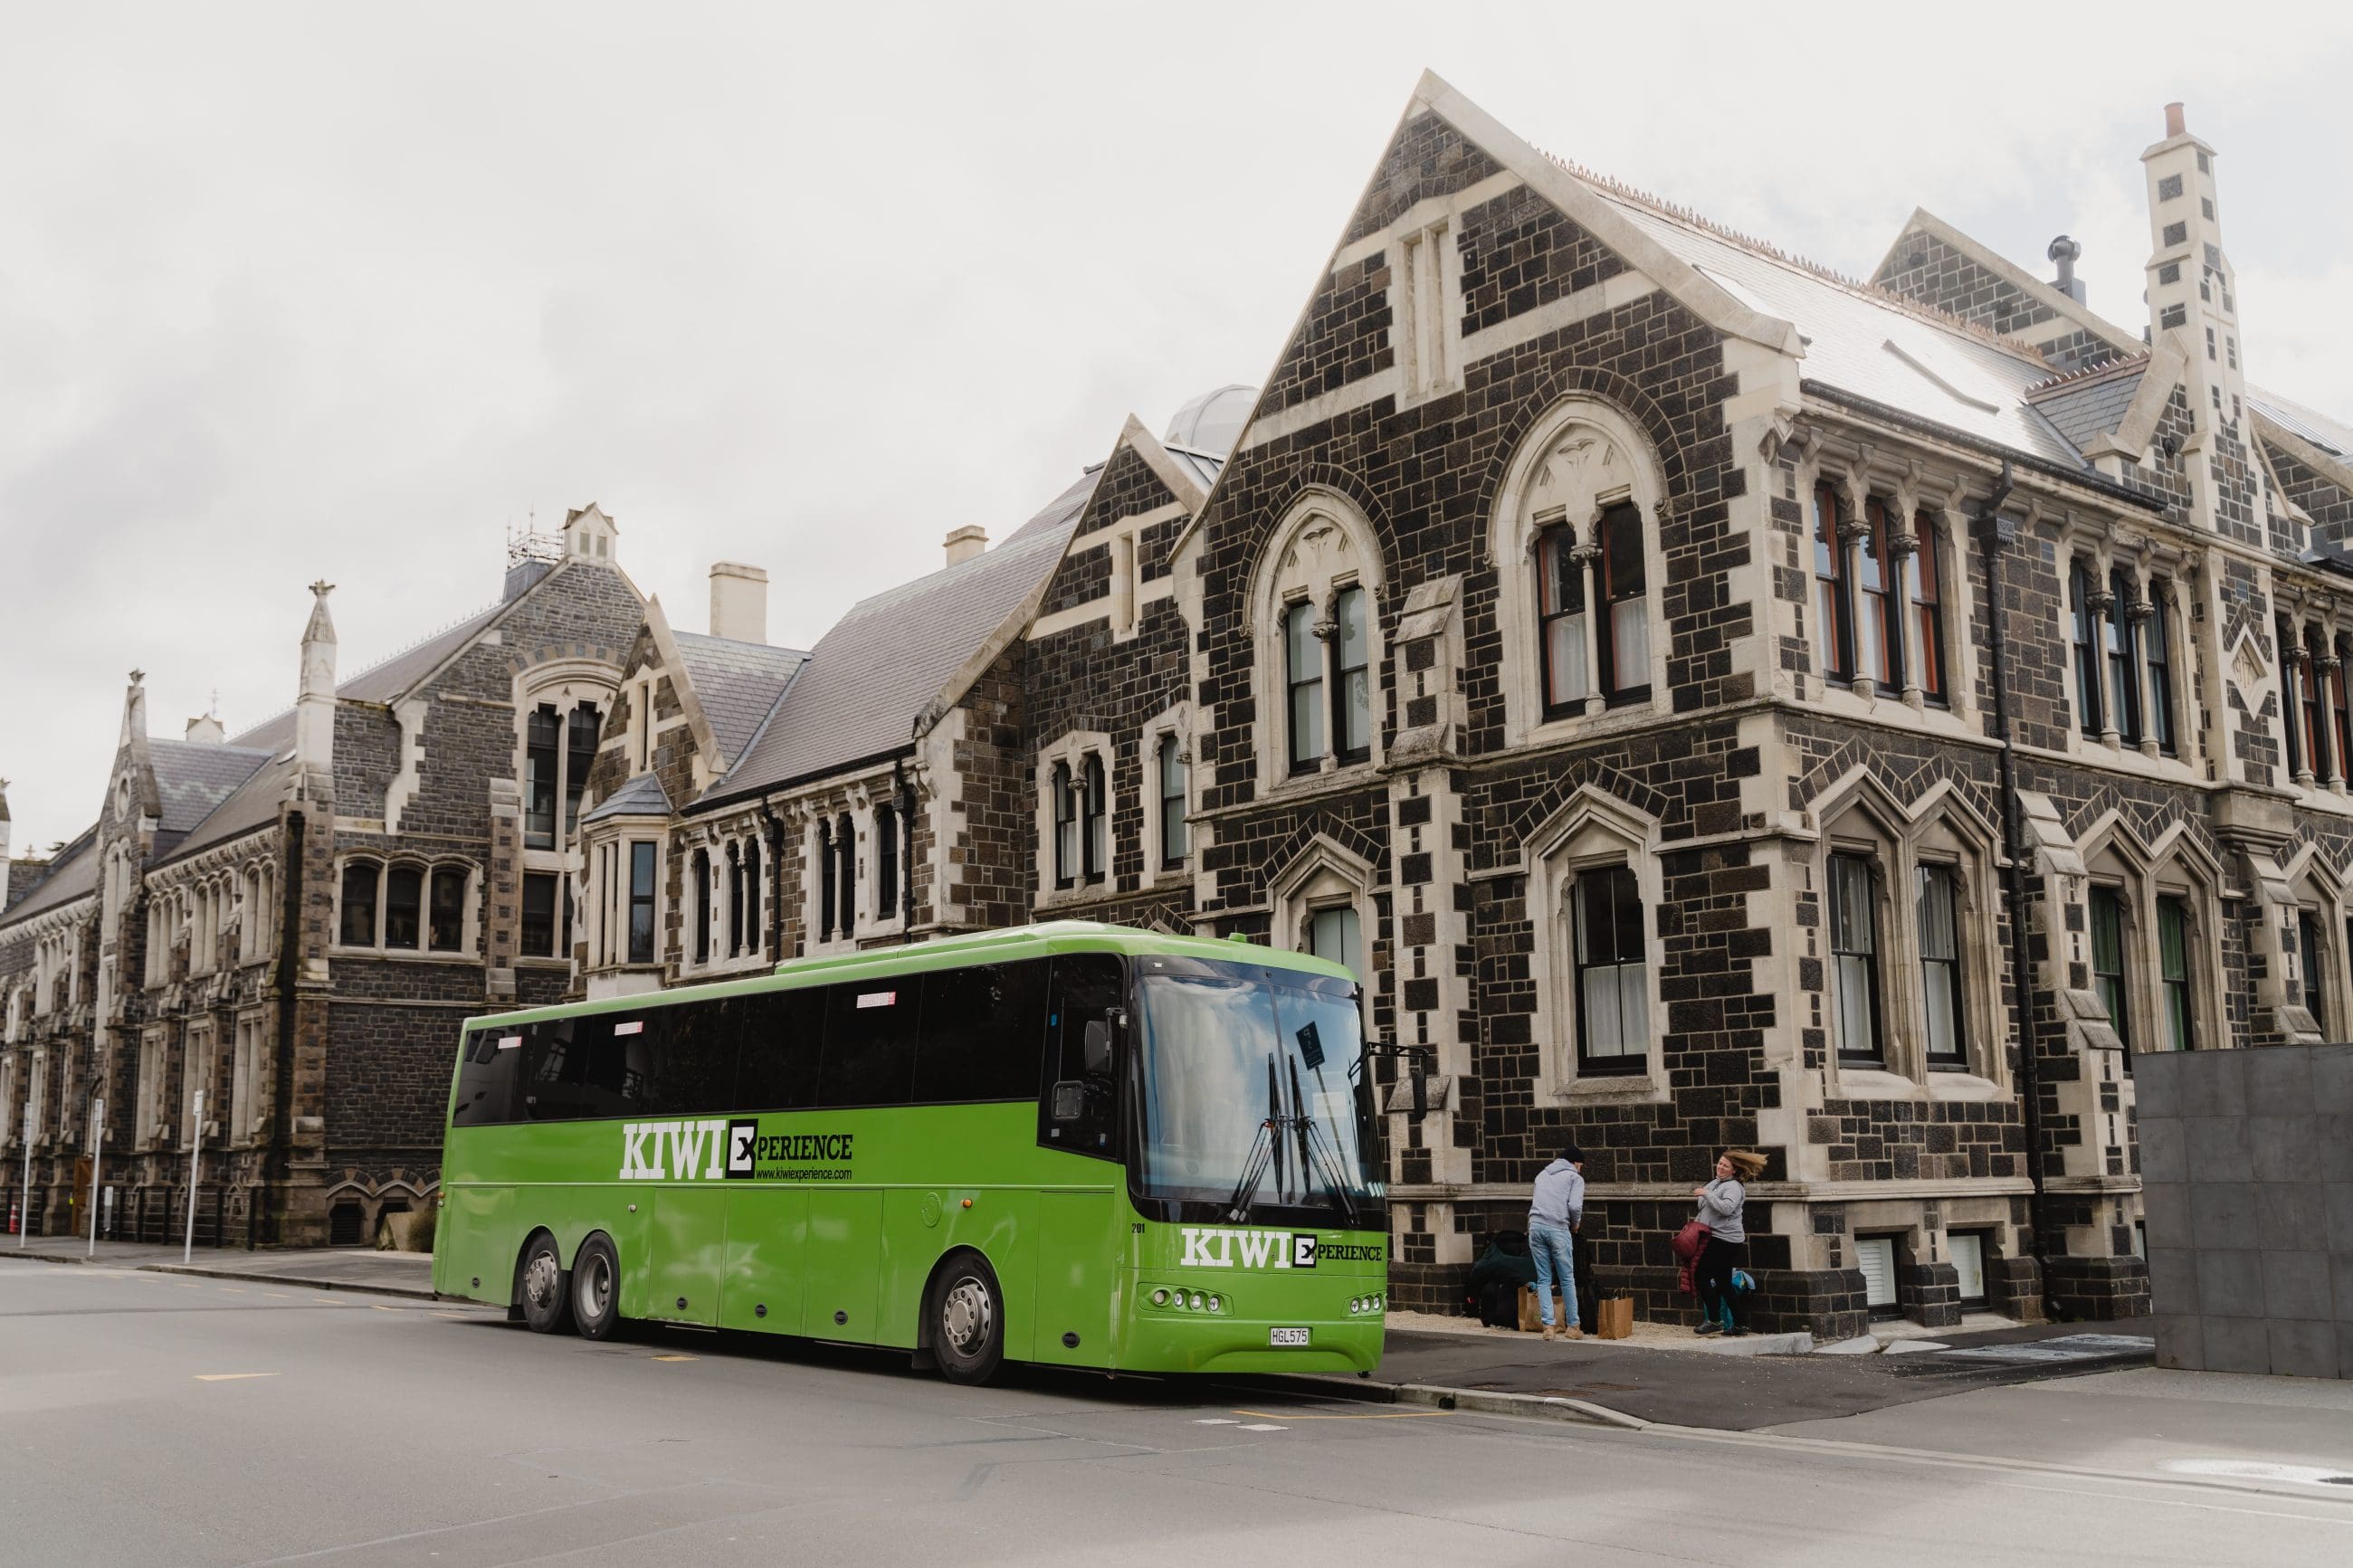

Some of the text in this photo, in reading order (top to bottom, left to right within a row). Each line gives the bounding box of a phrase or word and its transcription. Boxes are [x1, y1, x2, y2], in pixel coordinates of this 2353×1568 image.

[619, 1119, 727, 1180] KIWI
[756, 1166, 853, 1183] www.kiwiexperience.com
[1131, 1222, 1145, 1234] 201
[1180, 1228, 1291, 1269] KIWI
[1272, 1330, 1308, 1343] HGL575
